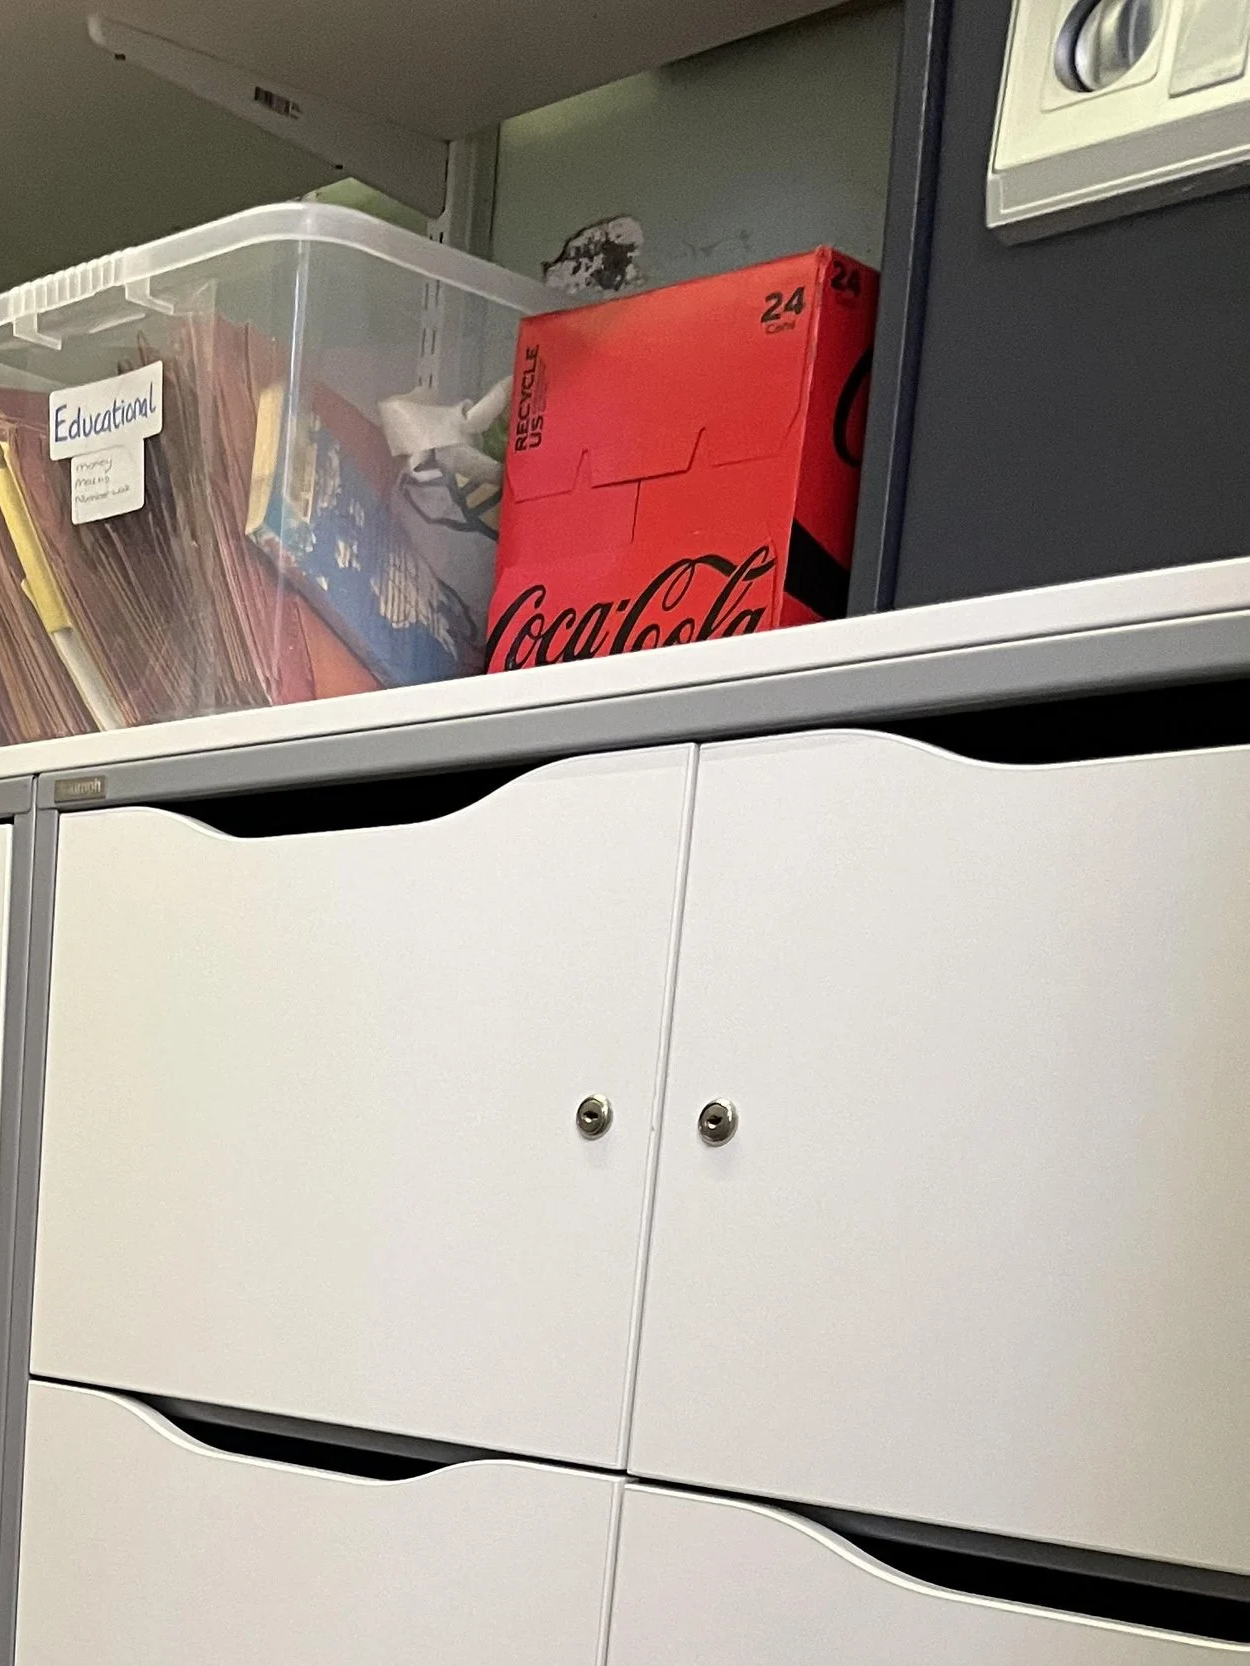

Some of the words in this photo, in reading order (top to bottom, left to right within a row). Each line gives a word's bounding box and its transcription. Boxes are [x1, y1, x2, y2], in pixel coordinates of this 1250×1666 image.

[831, 261, 860, 297] 24
[760, 286, 805, 323] 24
[55, 381, 157, 442] Educational
[515, 344, 539, 452] RECYCLE
[529, 415, 544, 449] US
[484, 545, 777, 675] Coca-Cola
